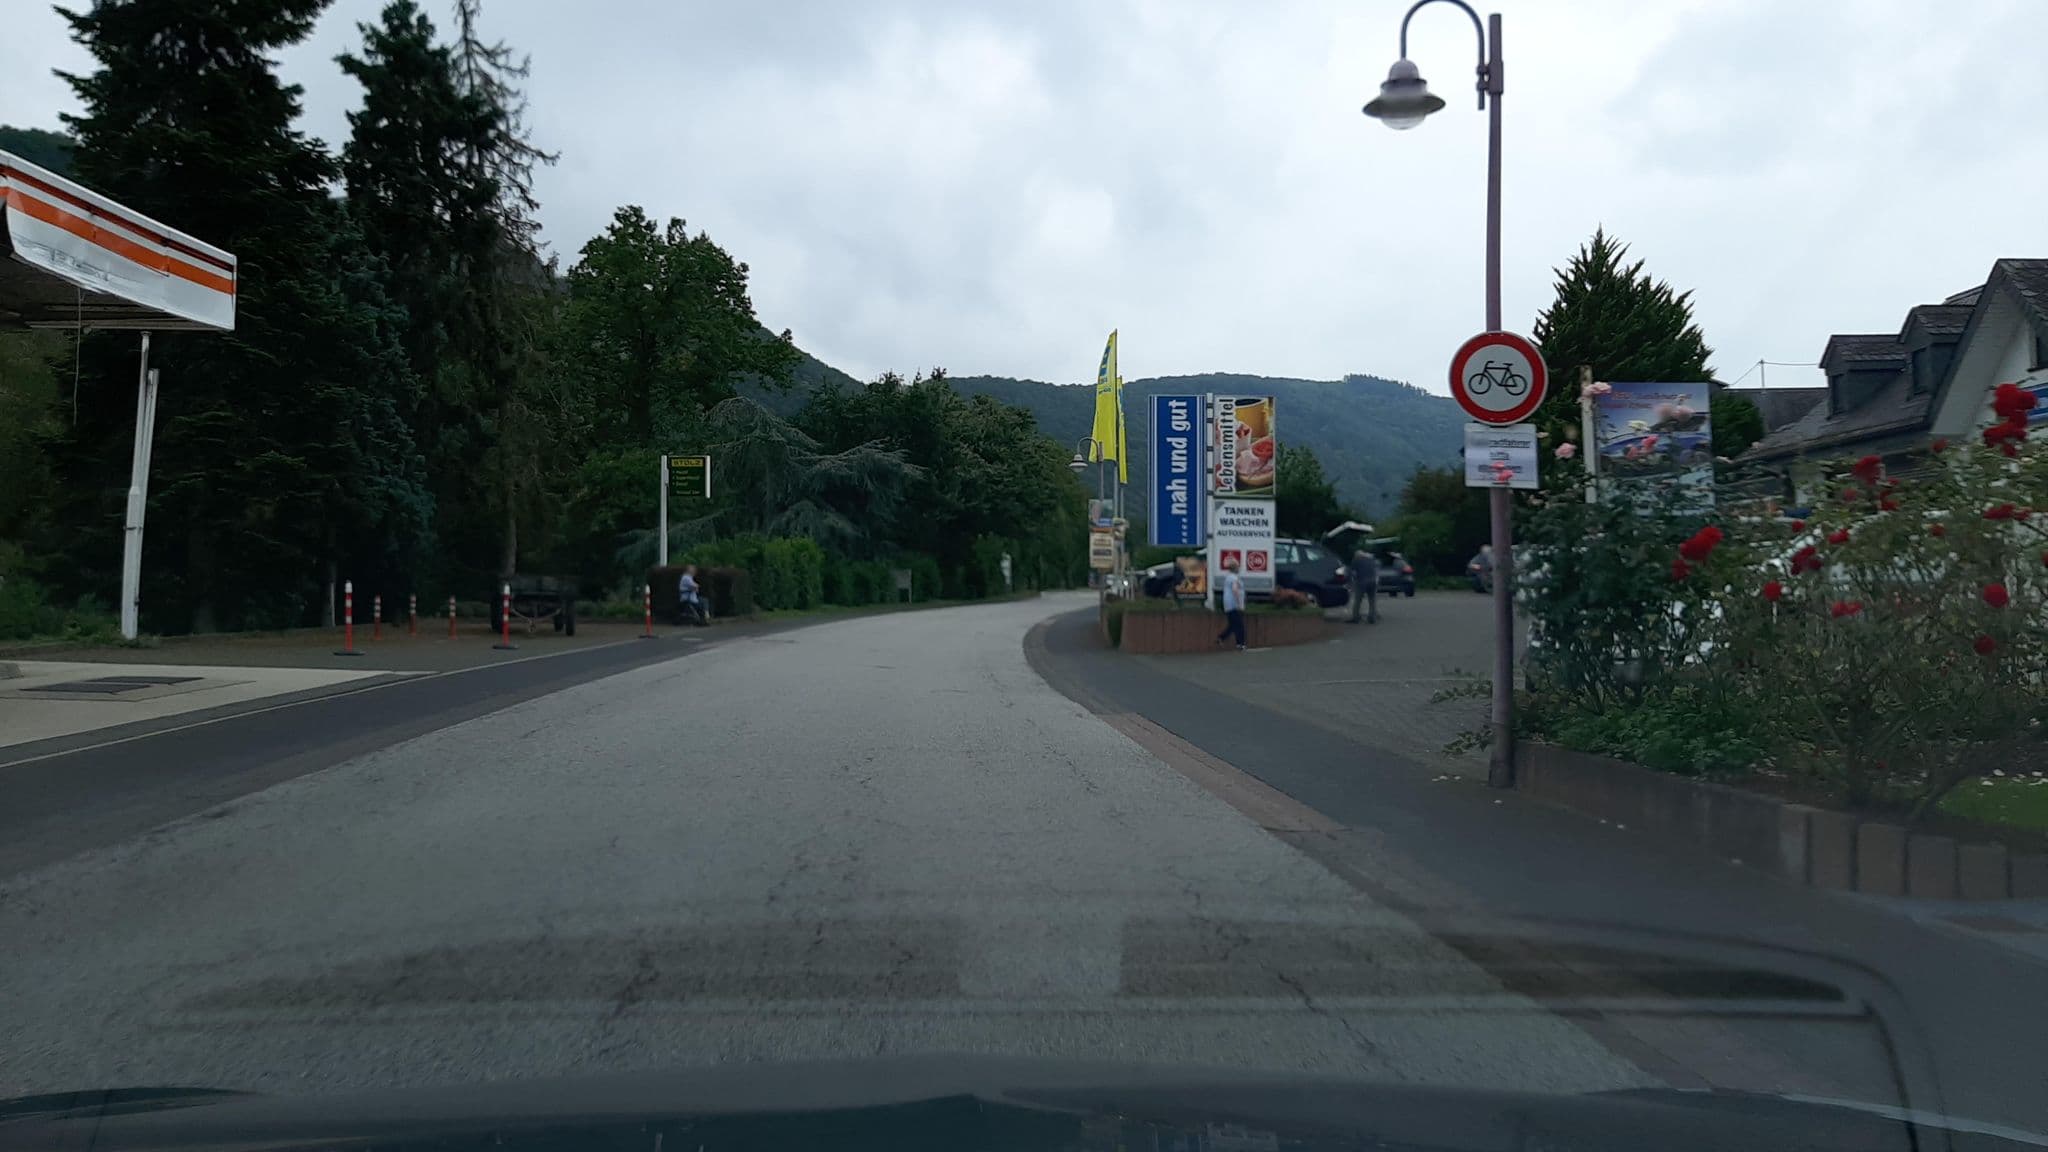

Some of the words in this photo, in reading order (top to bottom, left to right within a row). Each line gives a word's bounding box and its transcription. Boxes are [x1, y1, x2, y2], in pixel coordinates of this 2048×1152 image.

[1168, 399, 1191, 431] gut
[1166, 437, 1188, 473] und
[1218, 398, 1234, 492] Lebensmittel
[1223, 506, 1265, 516] TANKEN
[1219, 517, 1269, 527] WASCHEN
[1217, 530, 1272, 539] AUTOSERVICE
